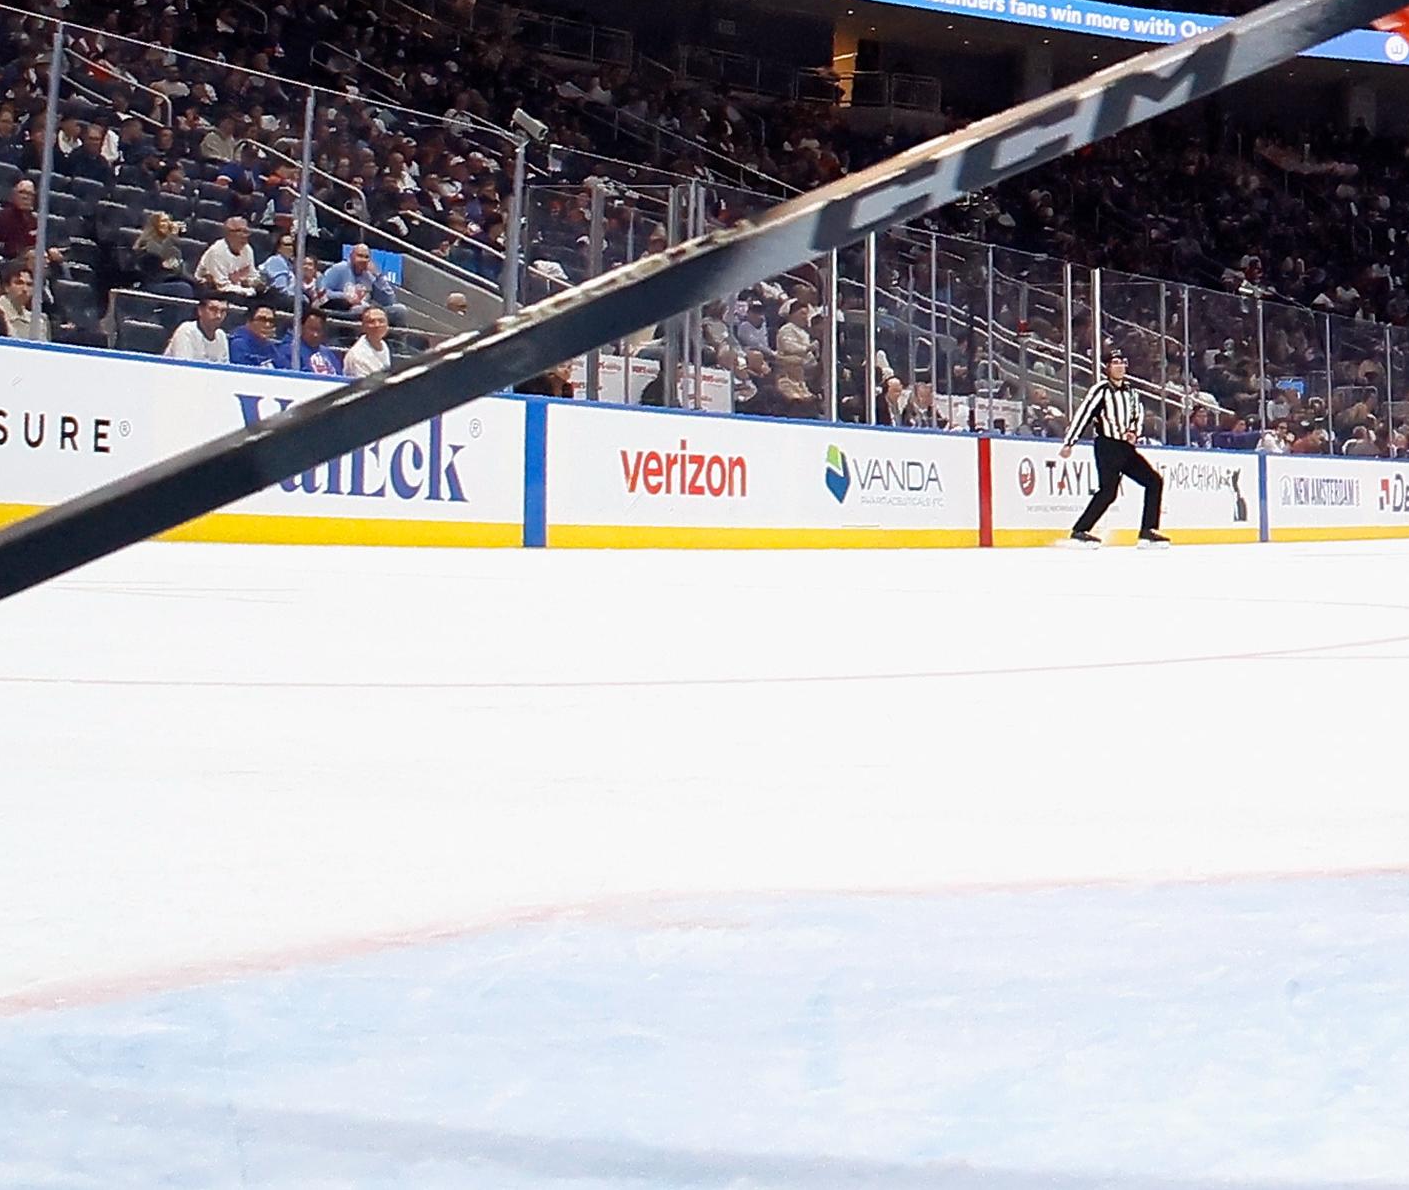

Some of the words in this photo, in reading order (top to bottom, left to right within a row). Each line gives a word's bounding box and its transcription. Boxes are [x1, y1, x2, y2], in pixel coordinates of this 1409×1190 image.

[1049, 3, 1083, 24] win
[1084, 9, 1131, 32] more
[1133, 10, 1178, 36] with
[814, 31, 1236, 247] CCM
[620, 439, 747, 497] verizon
[852, 458, 943, 492] VANDA
[1045, 460, 1125, 496] TAYL
